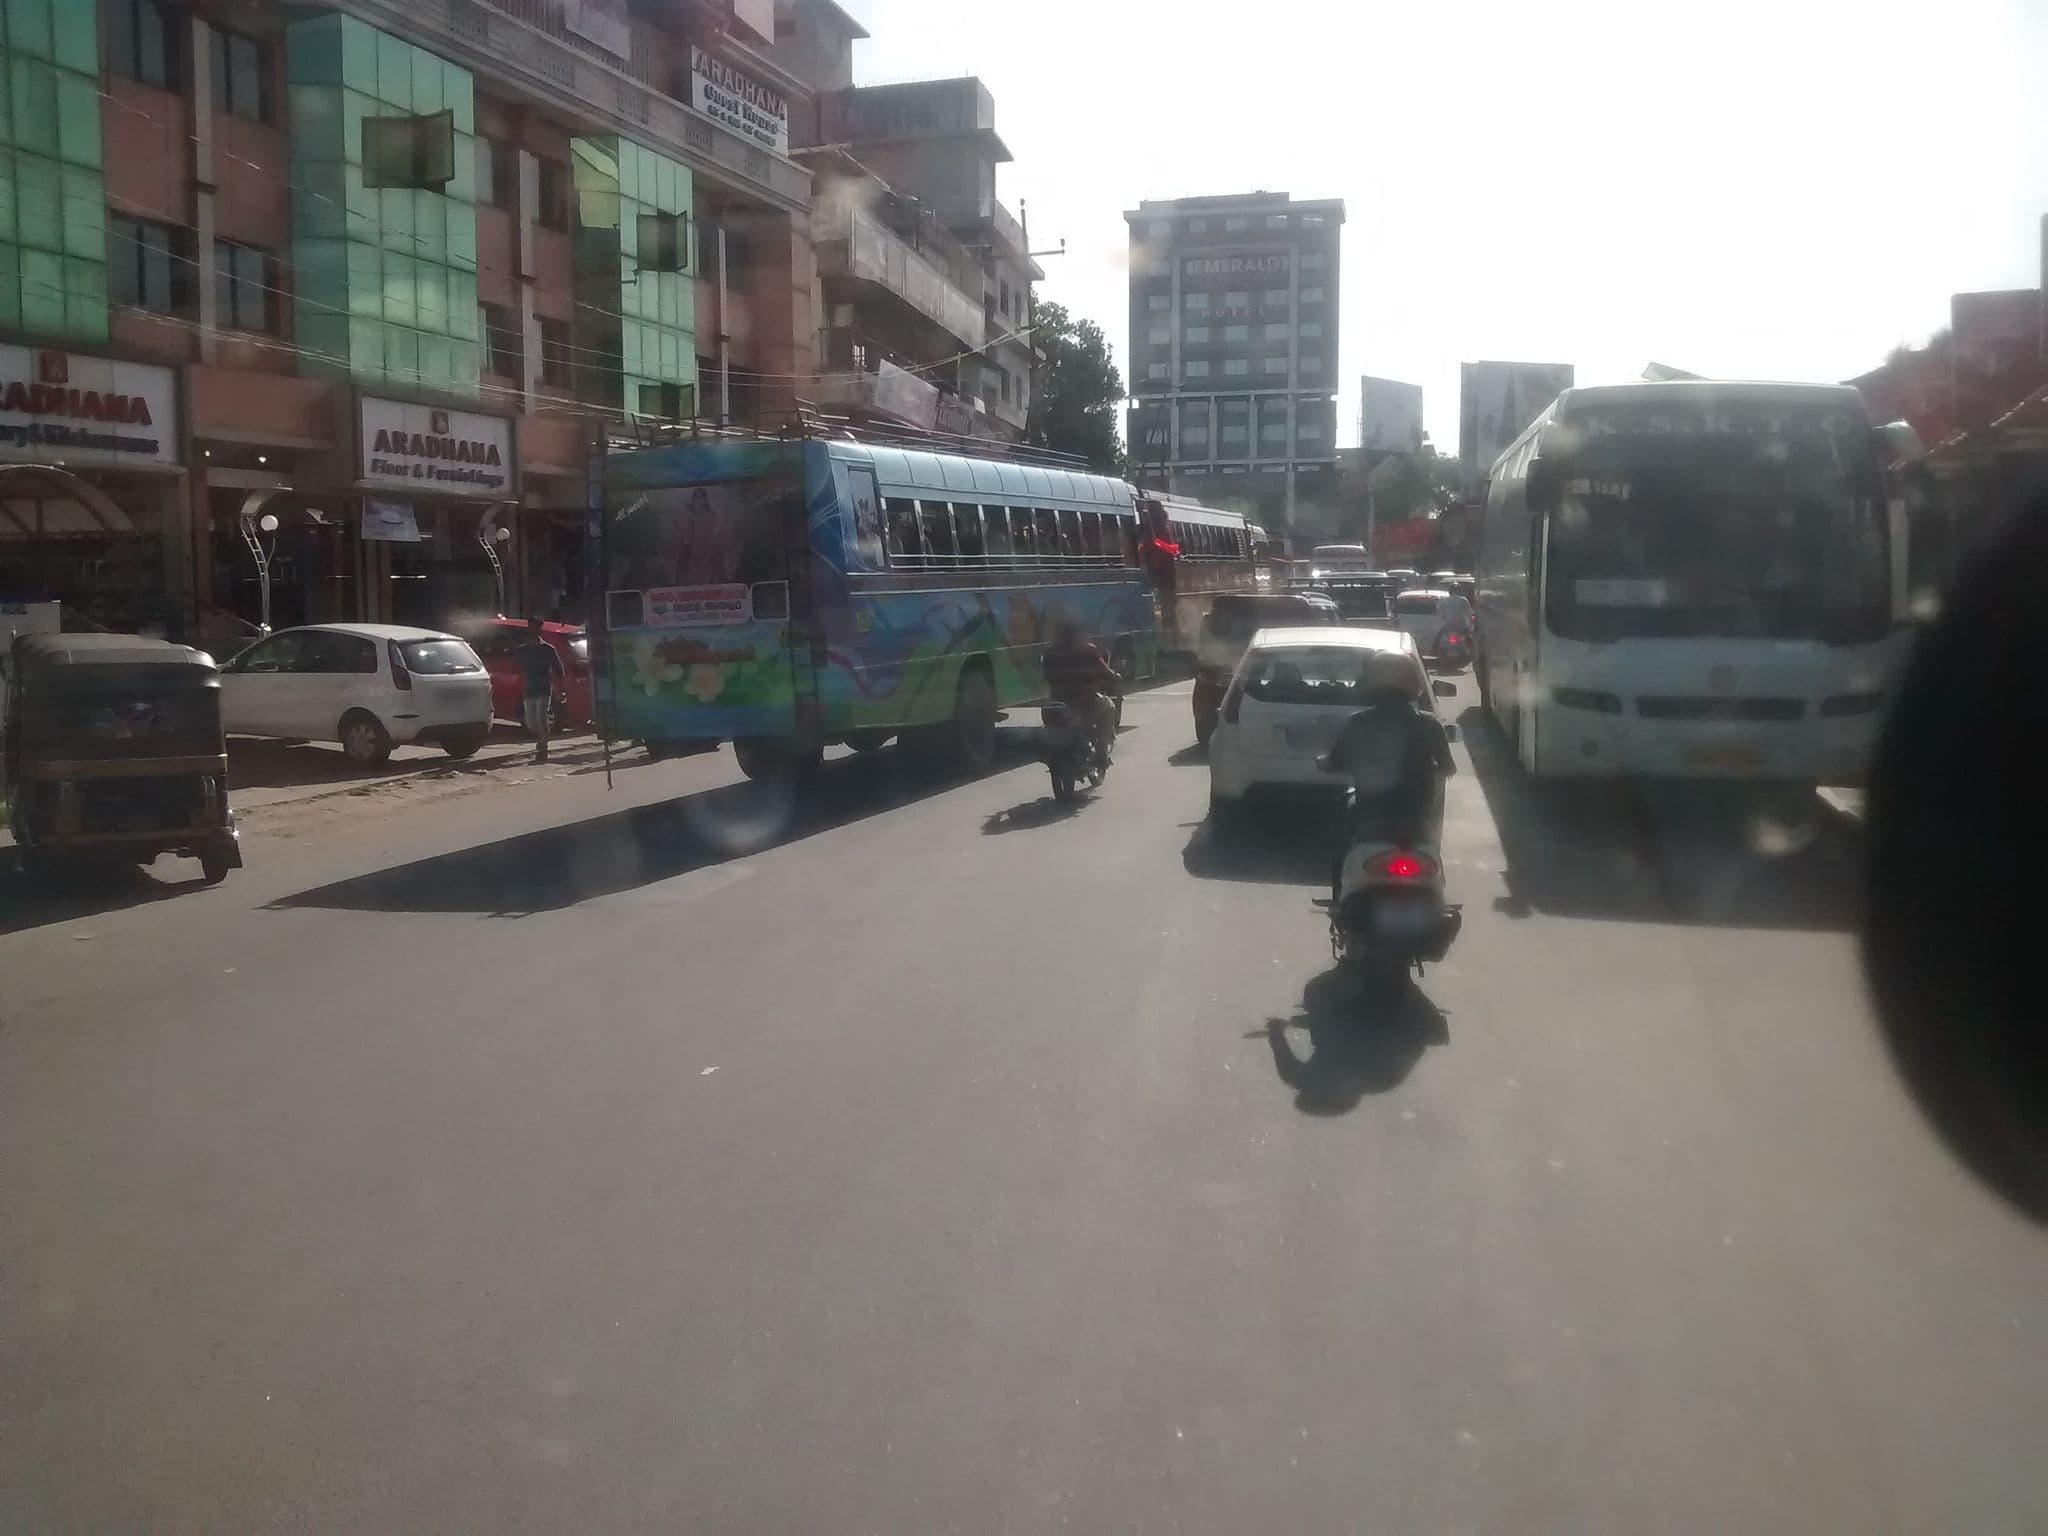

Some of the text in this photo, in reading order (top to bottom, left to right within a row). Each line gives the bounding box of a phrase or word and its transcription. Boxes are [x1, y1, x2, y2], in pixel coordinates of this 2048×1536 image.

[700, 53, 786, 120] ARADHANA
[0, 381, 153, 426] ADHANA
[373, 429, 502, 466] ARADHANA
